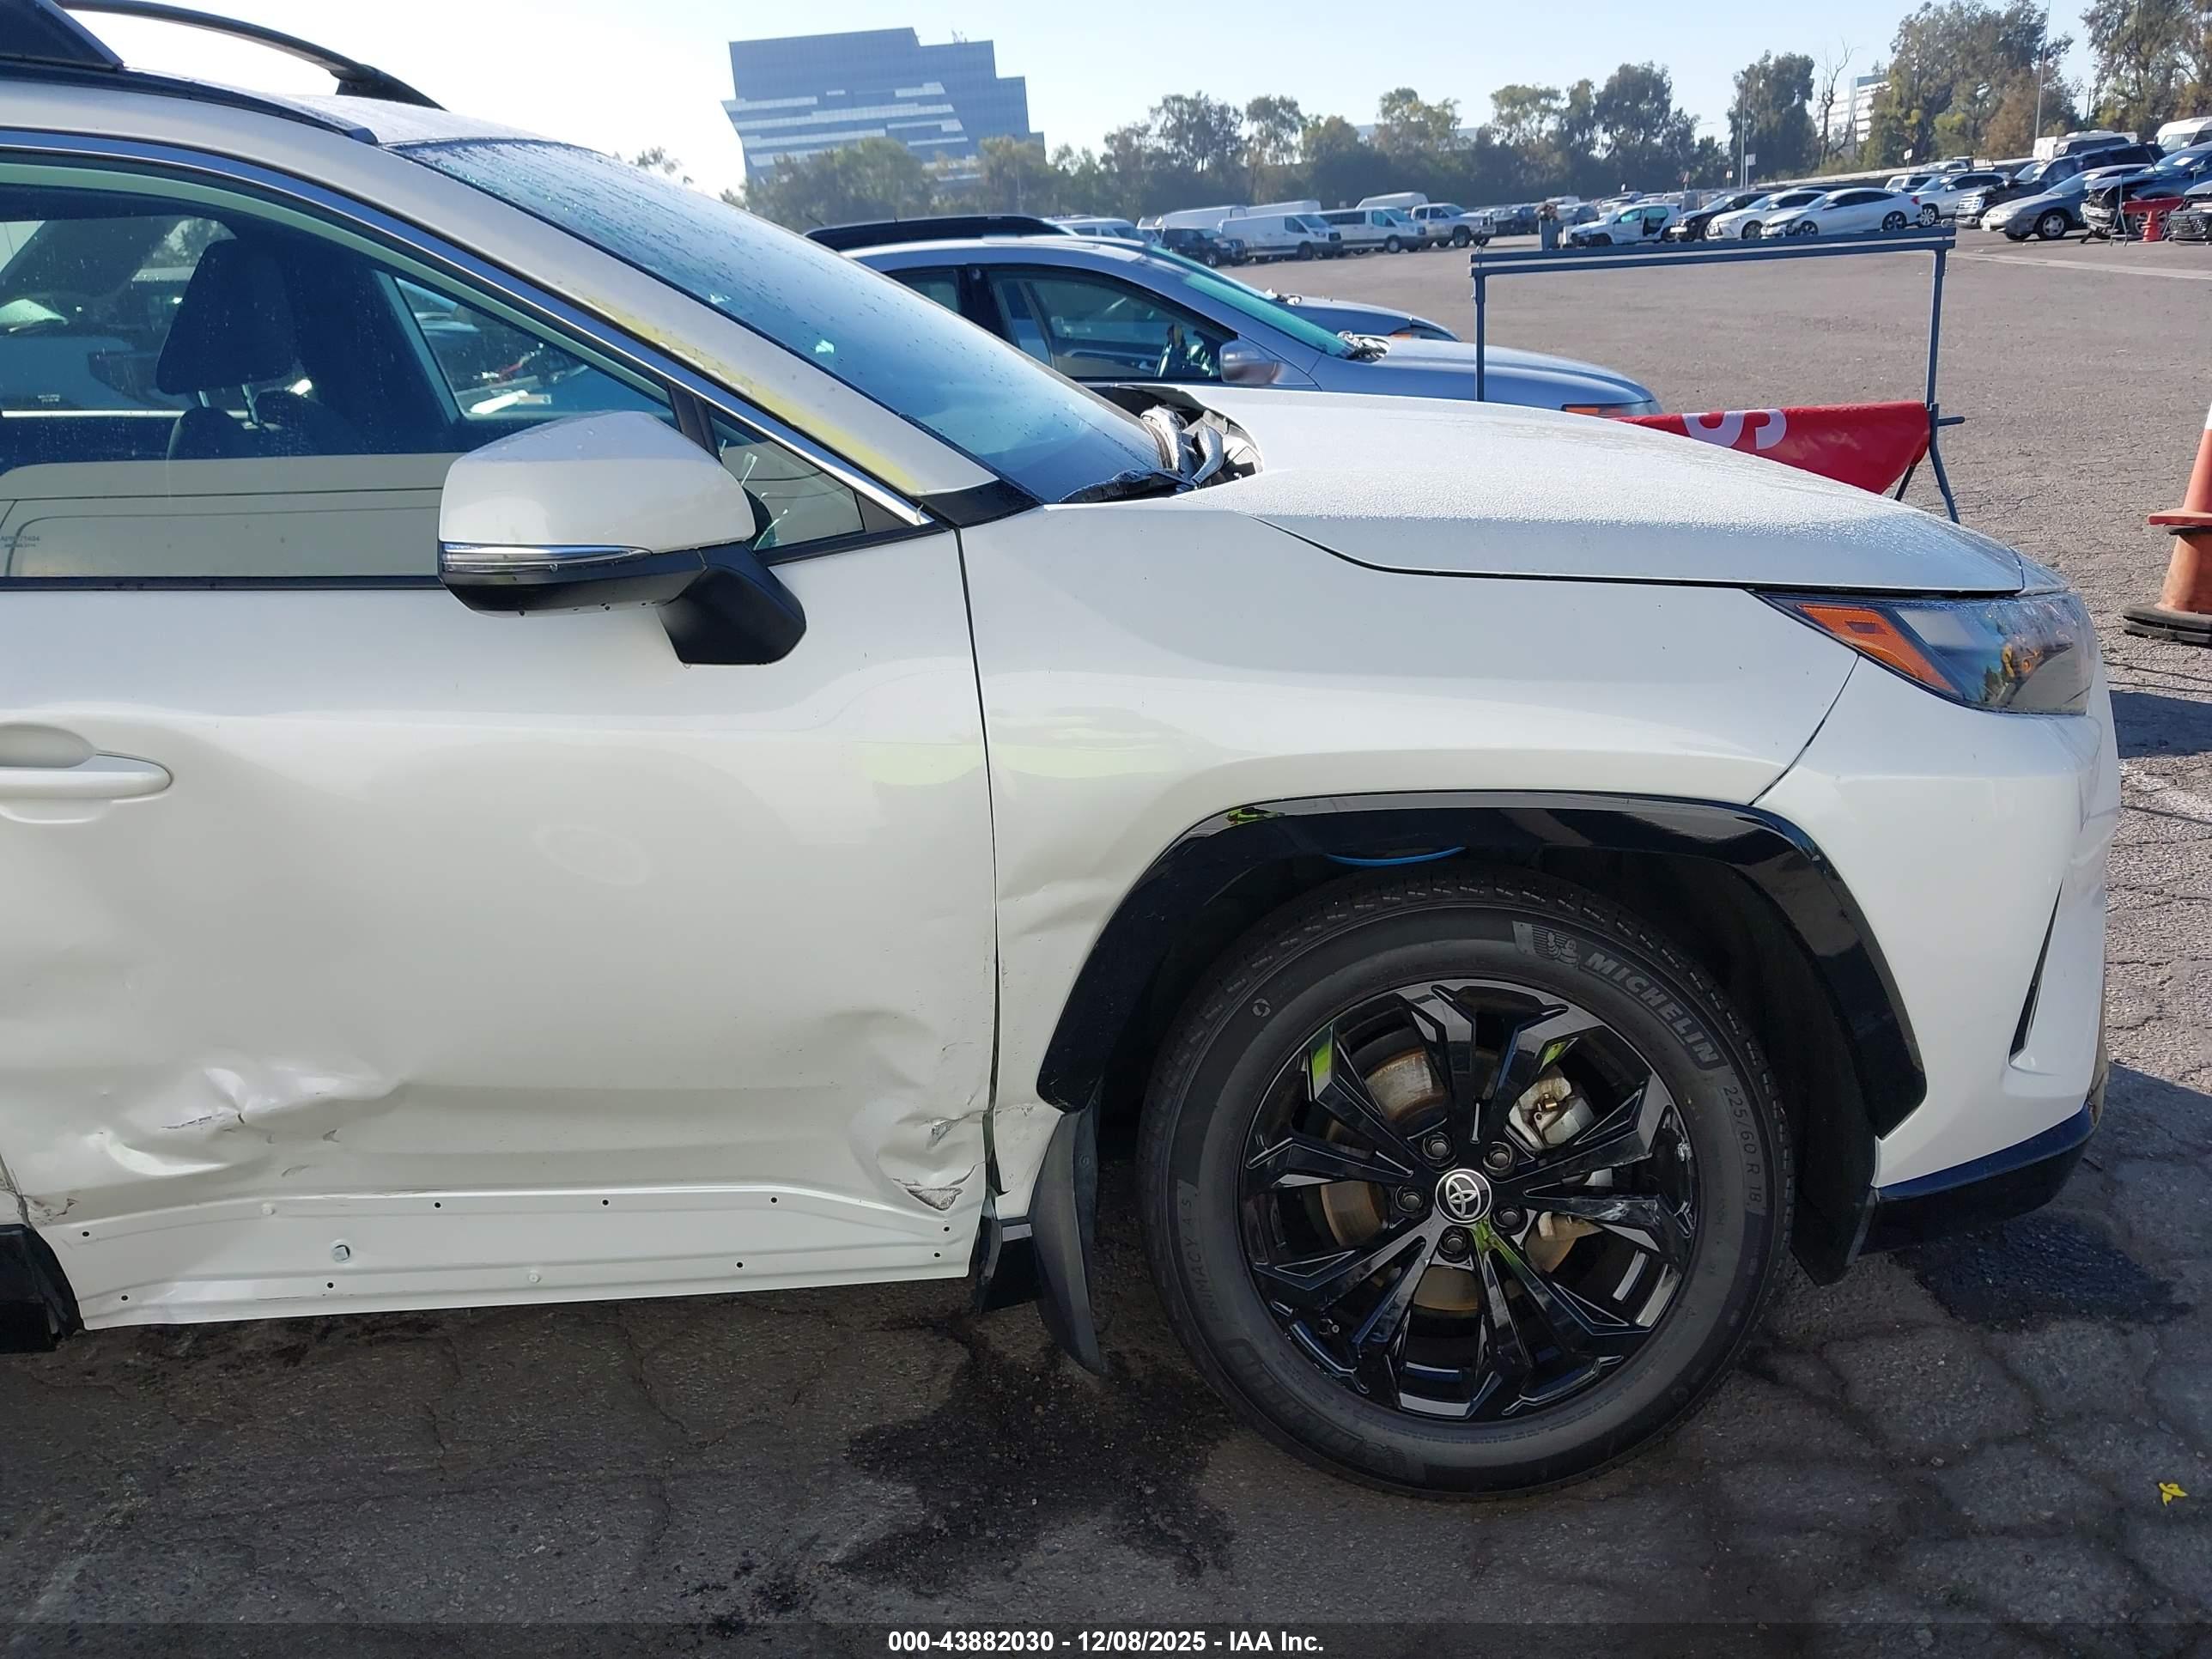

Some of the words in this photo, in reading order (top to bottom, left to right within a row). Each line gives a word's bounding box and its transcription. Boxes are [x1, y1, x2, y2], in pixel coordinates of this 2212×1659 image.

[1585, 951, 1719, 1062] MICHELIN
[1723, 1086, 1757, 1154] 225/60
[1747, 1163, 1760, 1175] R
[1749, 1187, 1762, 1202] 18
